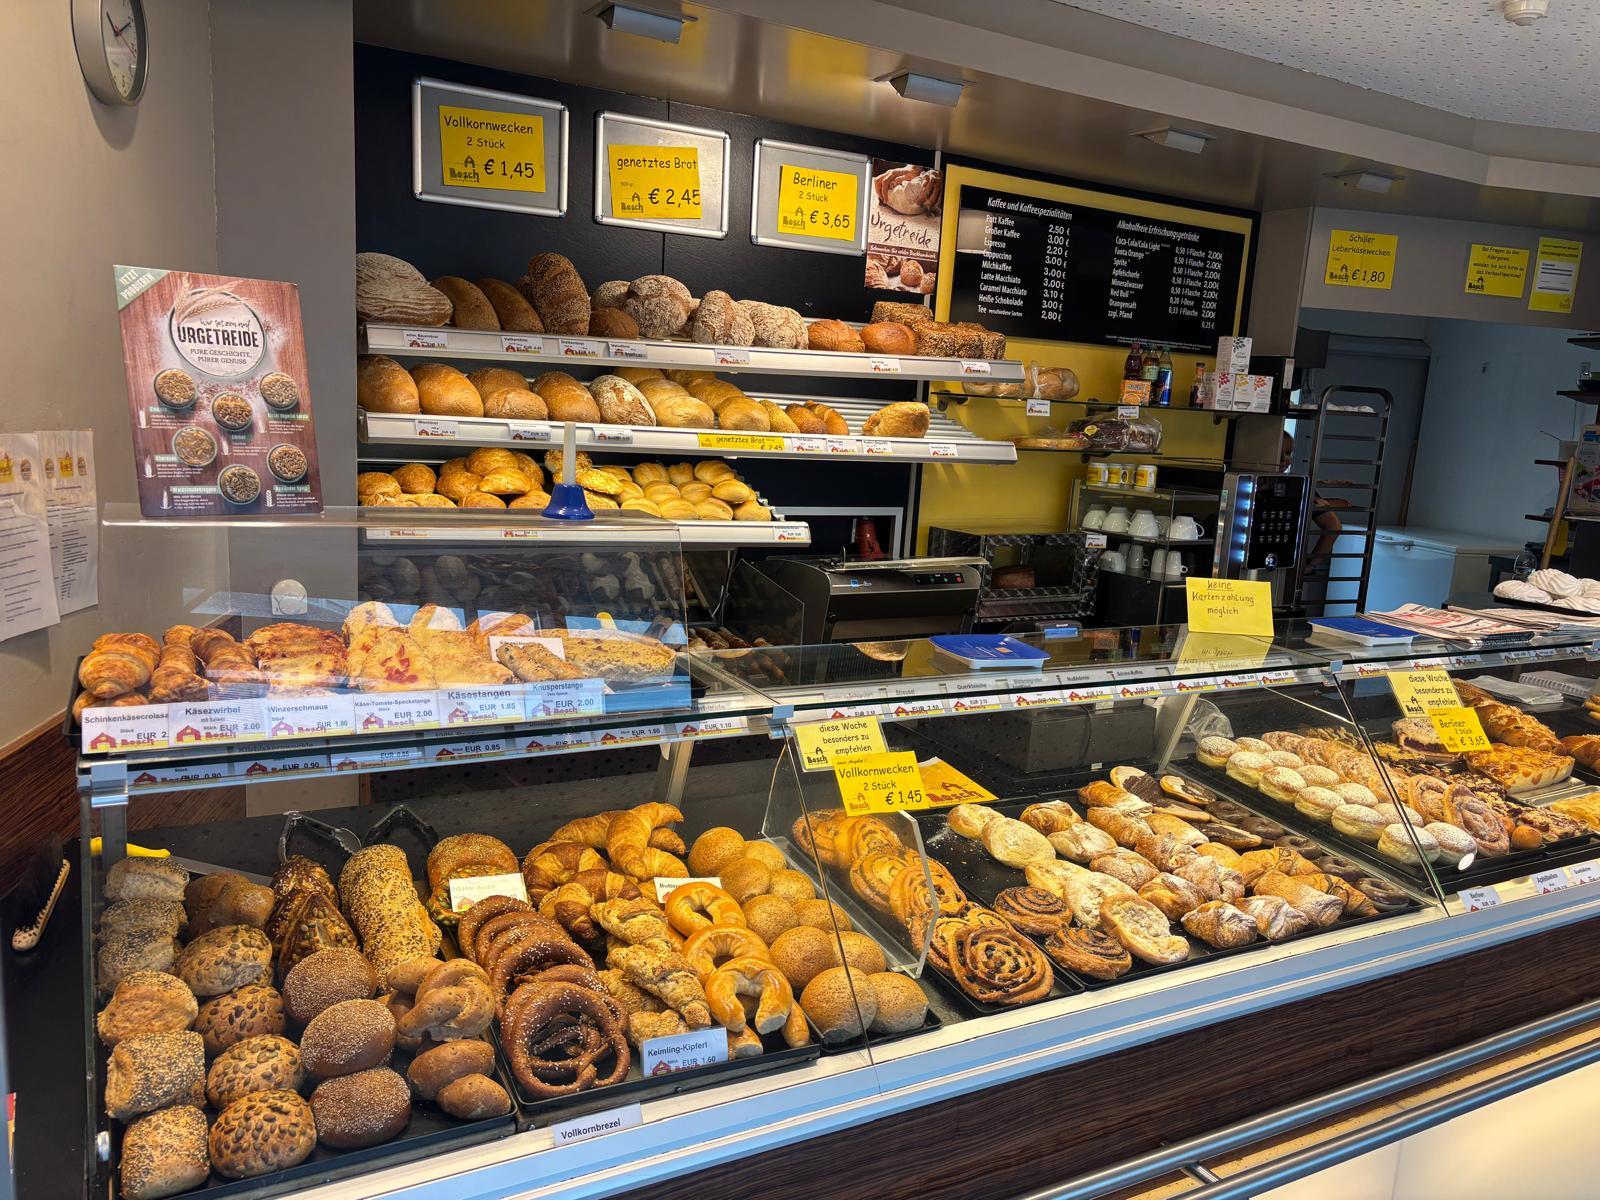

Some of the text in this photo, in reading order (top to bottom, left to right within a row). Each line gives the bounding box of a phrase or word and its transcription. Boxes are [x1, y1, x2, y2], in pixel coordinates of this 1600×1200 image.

[444, 115, 533, 134] Vollkornwecken
[467, 137, 505, 149] 2 Stück
[484, 159, 534, 179] € 1,45
[617, 157, 697, 170] genetztes Brot
[449, 168, 479, 183] Bosch
[794, 172, 837, 190] Berliner
[648, 188, 700, 208] € 2,45
[799, 191, 828, 202] 2 Stück
[621, 203, 643, 213] Bosch
[988, 197, 1072, 220] Kaffee und Kaffeespezialitäten
[783, 216, 806, 230] Bosch
[810, 211, 850, 228] € 3,65
[998, 216, 1014, 226] Kaffee
[871, 212, 931, 248] Urgetreide
[985, 226, 1020, 239] Großer Kaffee
[1048, 224, 1064, 235] 2,50
[1117, 220, 1200, 242] Alkoholfreie Erfrischungsgetränke
[984, 237, 1006, 249] Espresso
[1048, 235, 1064, 245] 3,00
[1115, 236, 1148, 249] Coca-Cola/Cola
[1148, 242, 1160, 252] Light
[983, 250, 1012, 260] Cappuccino
[1047, 246, 1063, 256] 2,20
[1114, 247, 1144, 260] Fanta Orange
[1332, 244, 1390, 256] Leberkäsewecken
[982, 260, 1012, 272] Milchkaffee
[1045, 256, 1062, 266] 3,00
[1113, 258, 1128, 266] Sprite
[981, 272, 1021, 284] Latte Macchiato
[1044, 268, 1061, 278] 3,00
[1112, 268, 1140, 279] Apfelschorle
[1329, 272, 1348, 282] Bosch
[1352, 270, 1385, 283] € 1,80
[1043, 278, 1060, 289] 3,00
[1111, 278, 1144, 290] Mineralwasser
[1468, 283, 1484, 291] Bosch
[980, 283, 1028, 296] Caramel Macchiato
[1043, 289, 1058, 299] 3,10
[1110, 288, 1129, 298] Red Bull
[978, 294, 1024, 306] Heiße Schokolade
[1042, 300, 1058, 310] 3,00
[1109, 299, 1136, 309] Orangensaft
[978, 305, 986, 314] Tee
[1108, 310, 1132, 319] zzgl. Pfand
[1041, 311, 1058, 320] 2,80
[177, 326, 259, 347] URGETREIDE
[716, 436, 749, 444] genetztes
[1192, 592, 1254, 606] Kartenzahlung
[1208, 606, 1239, 617] möglich
[1427, 674, 1449, 682] Woche
[533, 682, 583, 691] Knusperstange
[448, 690, 511, 699] Käsestangen
[268, 704, 328, 712] Winzerschmaus
[1428, 698, 1458, 707] empfehlen
[185, 707, 241, 715] Käsezwirbel
[1406, 705, 1424, 714] Bosch
[220, 724, 239, 732] EUR
[819, 722, 868, 732] diese Woche
[1439, 719, 1466, 728] Berliner
[823, 734, 859, 744] besonders
[1460, 736, 1484, 746] € 3,65
[464, 744, 500, 753] EUR 0.85
[836, 745, 872, 756] empfehlen
[807, 756, 828, 764] Bosch
[838, 764, 914, 779] Vollkornwecken
[872, 781, 897, 790] Stück
[885, 790, 922, 805] € 1,45
[849, 802, 870, 811] Bosch
[648, 1042, 708, 1056] Keimling-Kipferl
[561, 1118, 621, 1139] Vollkornbrezel
